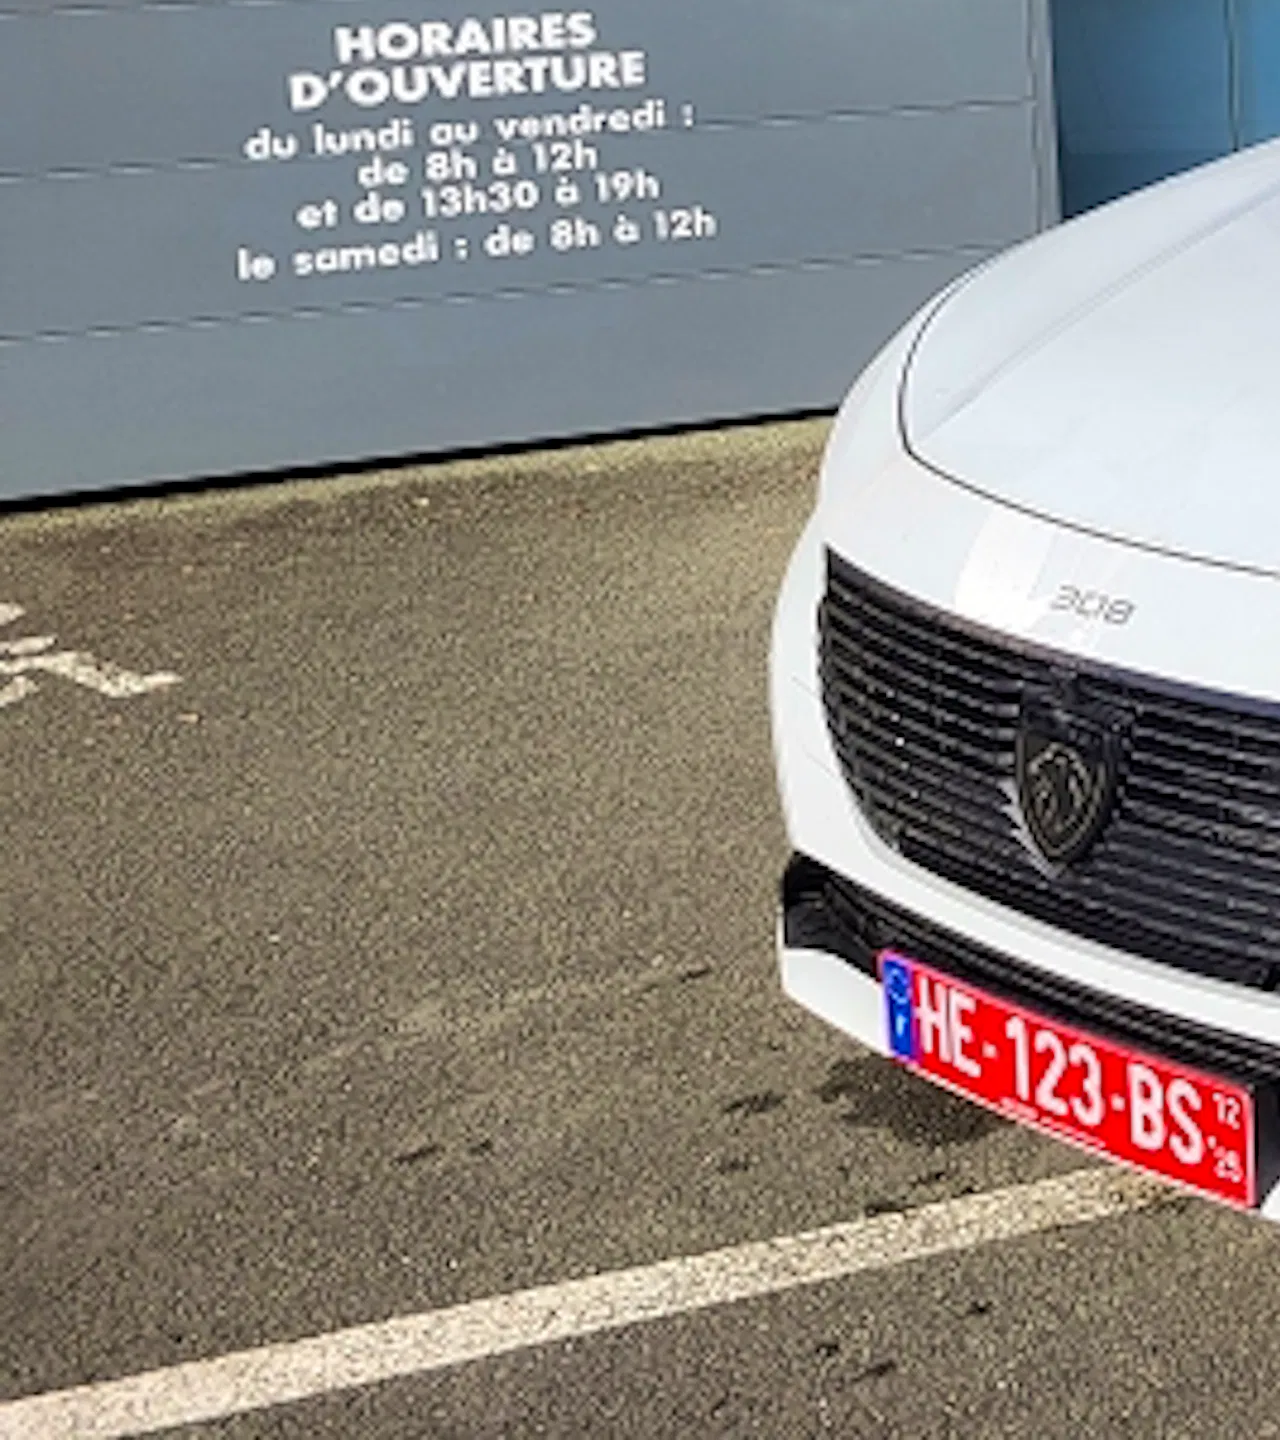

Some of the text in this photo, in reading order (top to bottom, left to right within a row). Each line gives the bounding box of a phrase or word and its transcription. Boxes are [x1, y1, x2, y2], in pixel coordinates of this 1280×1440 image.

[334, 11, 597, 64] HORAIRES
[244, 128, 297, 162] du
[314, 118, 414, 156] lundi
[429, 120, 479, 145] au
[494, 100, 666, 143] vendredi
[358, 139, 599, 189] de 8h à 12h
[297, 169, 661, 230] et de 13h30 à 19h
[236, 248, 276, 282] le
[293, 230, 440, 277] samedi
[483, 224, 535, 259] de
[549, 218, 601, 251] 8h
[612, 212, 640, 245] à
[654, 206, 717, 240] 12h
[1050, 582, 1137, 625] 308
[1211, 1091, 1243, 1132] 12
